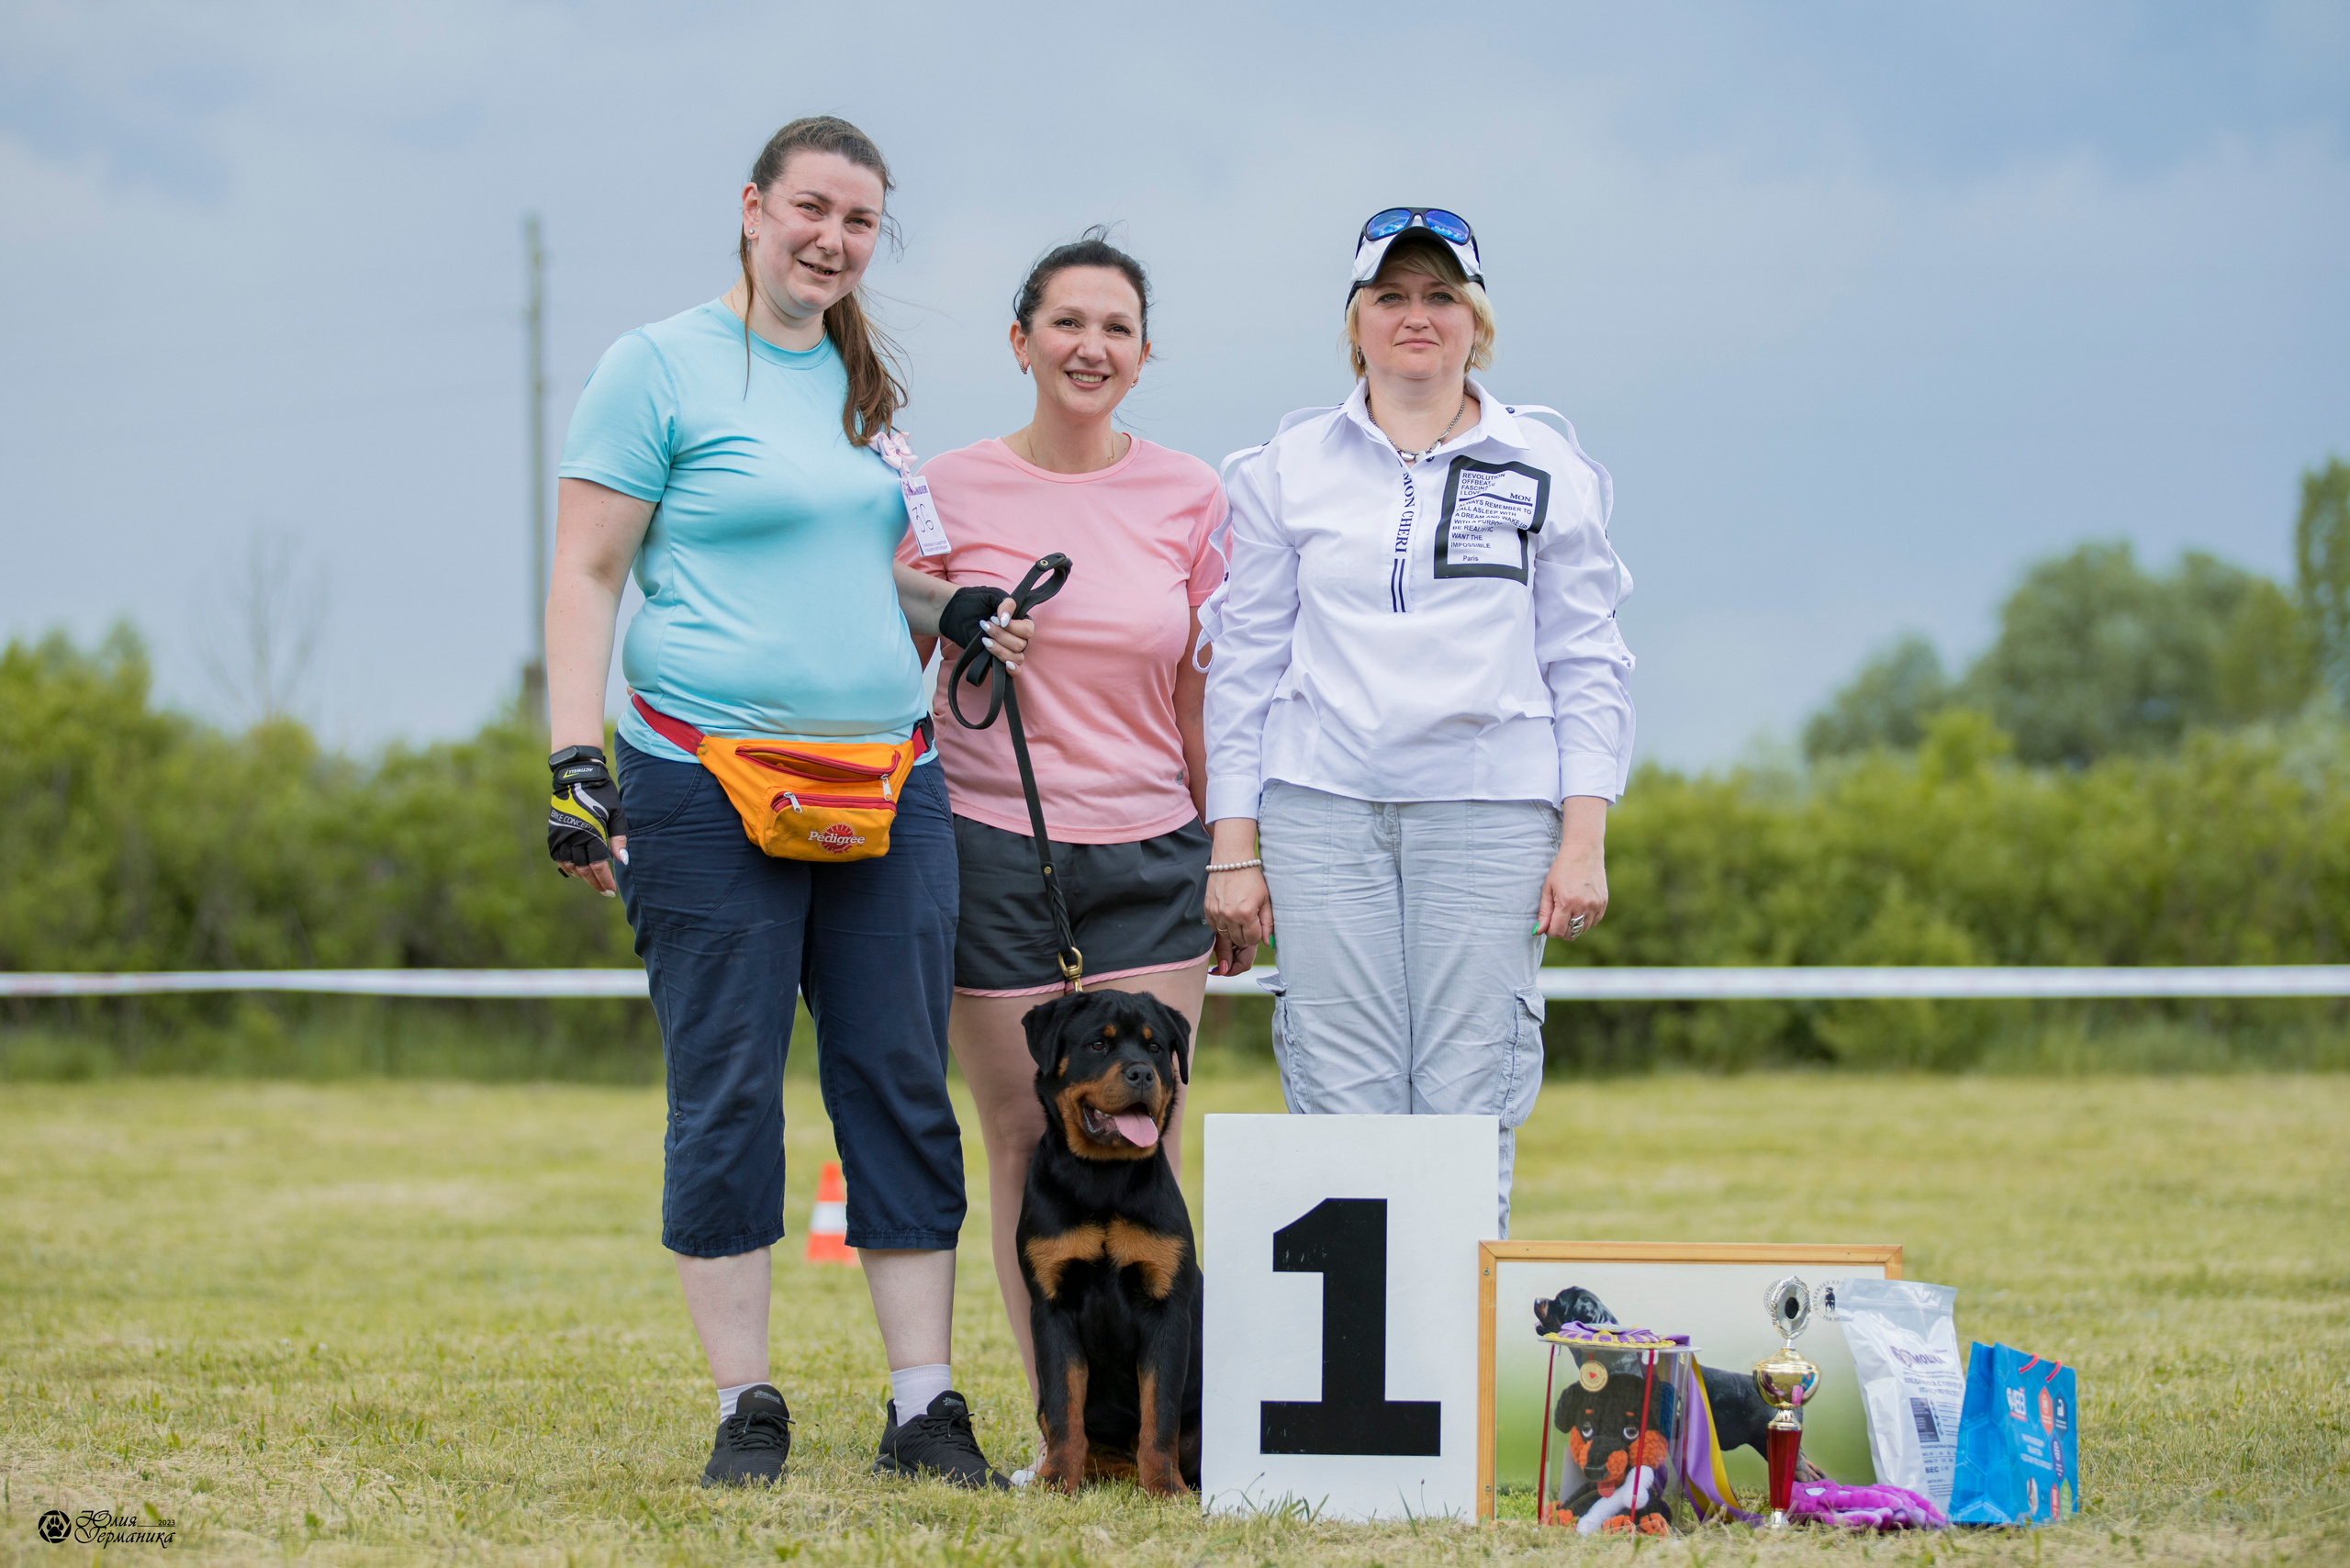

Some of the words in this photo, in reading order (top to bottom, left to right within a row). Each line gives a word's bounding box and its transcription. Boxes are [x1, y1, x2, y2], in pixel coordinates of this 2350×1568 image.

[1403, 472, 1415, 508] MON
[1509, 492, 1532, 502] MON
[1458, 499, 1484, 508] ALWAYS
[1484, 500, 1522, 512] REMEMBER
[1472, 506, 1499, 514] ASLEEP
[1502, 515, 1519, 527] WAKE
[1518, 521, 1528, 530] UP
[1394, 510, 1415, 553] CHERI
[550, 809, 564, 822] BIKE
[563, 815, 595, 832] CONCEPT
[807, 830, 867, 846] Pedigree
[1260, 1197, 1441, 1457] 1
